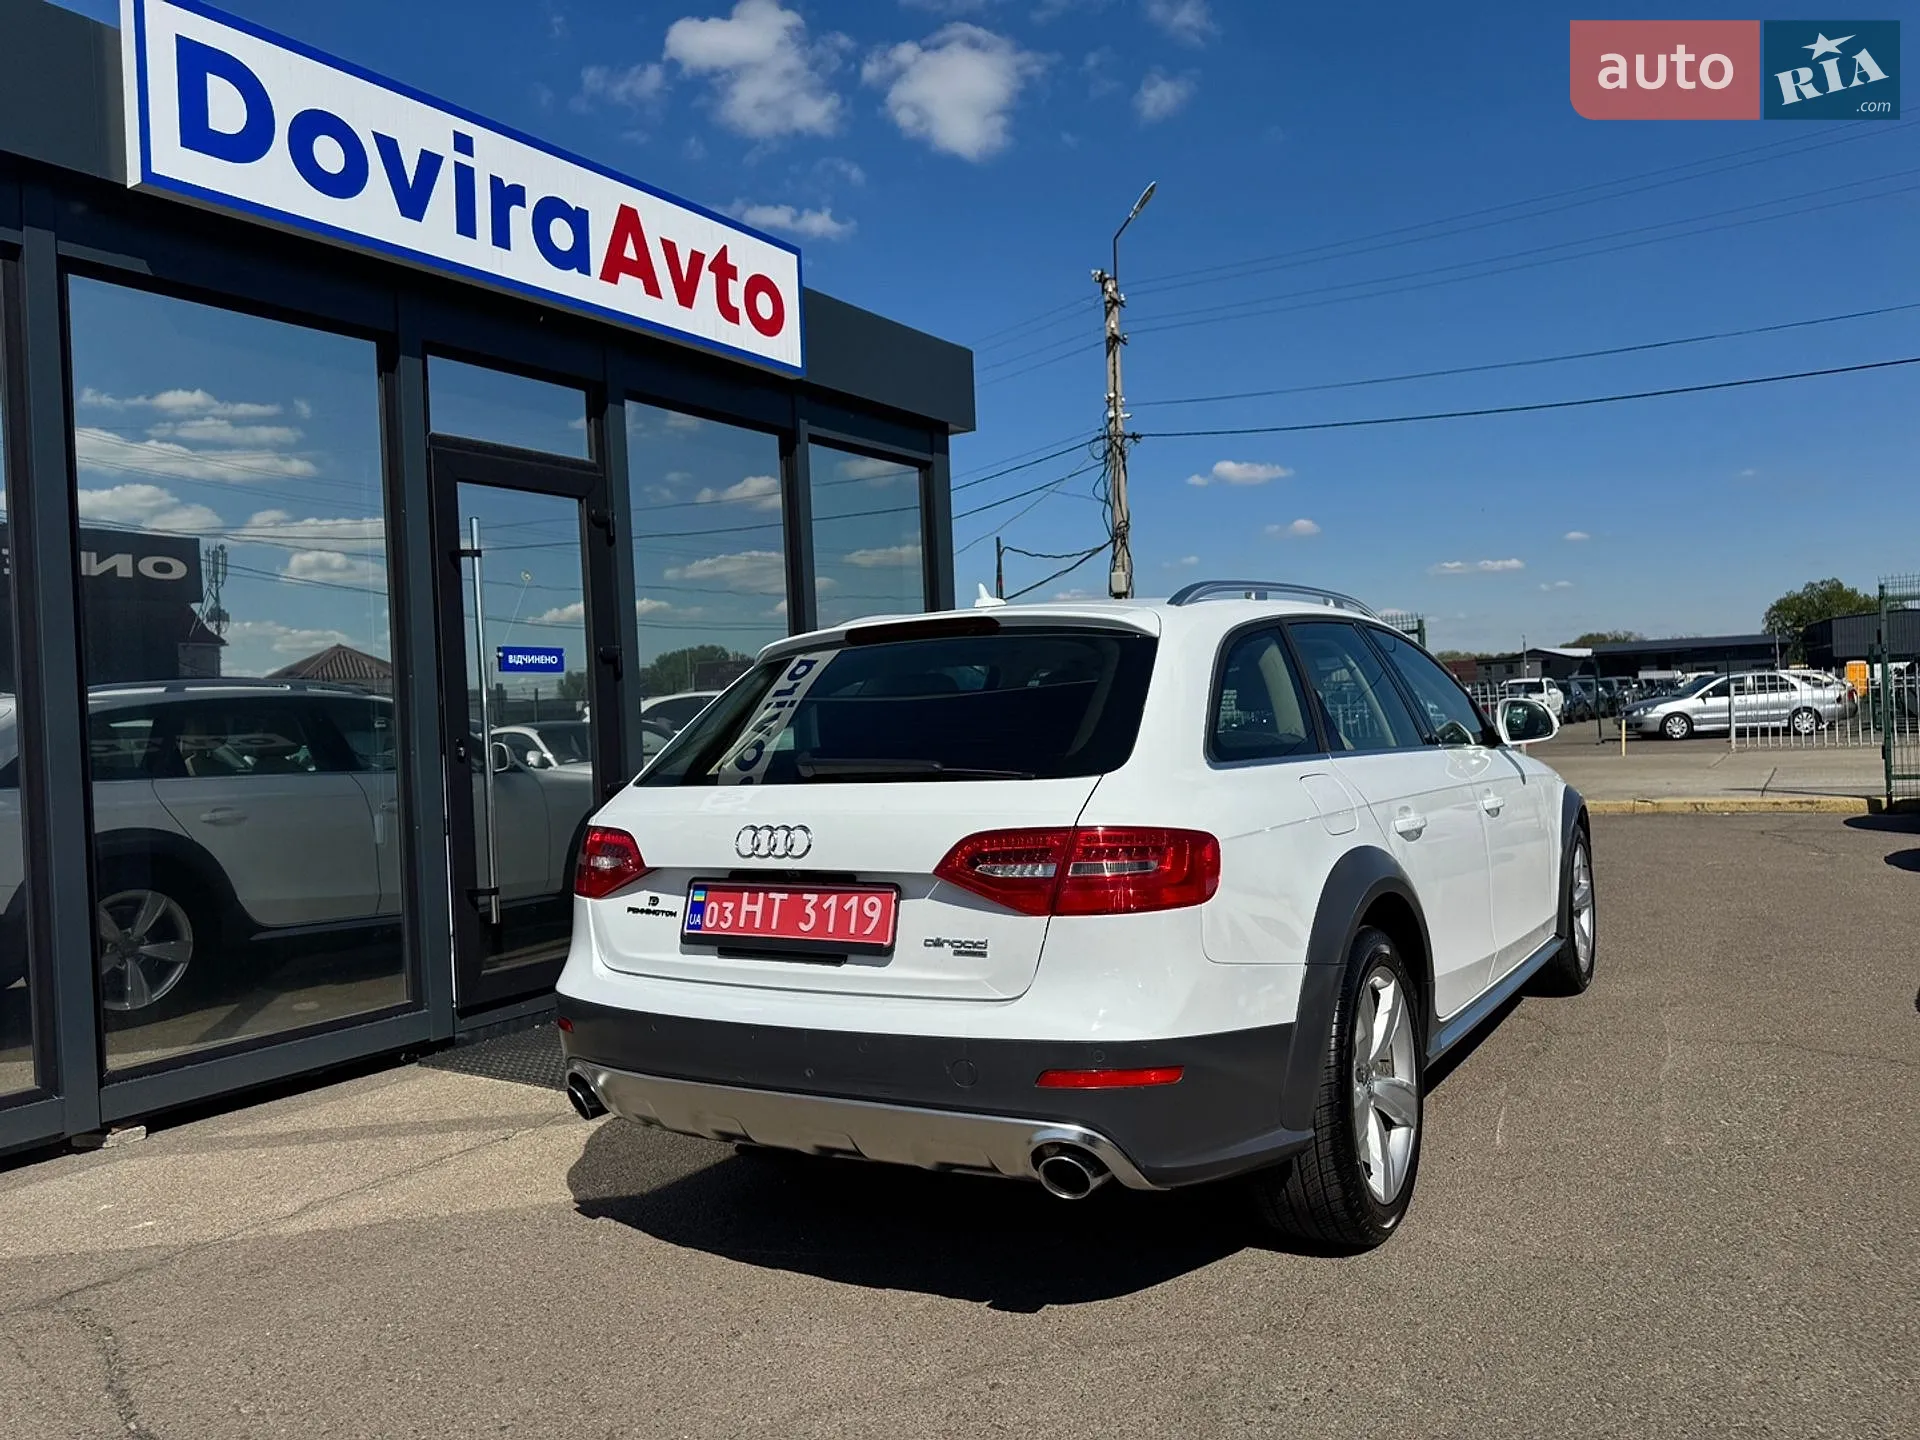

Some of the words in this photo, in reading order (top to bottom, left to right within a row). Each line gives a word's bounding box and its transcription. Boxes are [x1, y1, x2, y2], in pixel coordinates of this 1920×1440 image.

[175, 33, 785, 338] DoviraAvto
[508, 654, 558, 665] ВІДЧИНЕНО
[689, 913, 701, 926] UA
[797, 893, 883, 935] 3119
[923, 937, 988, 949] allroad
